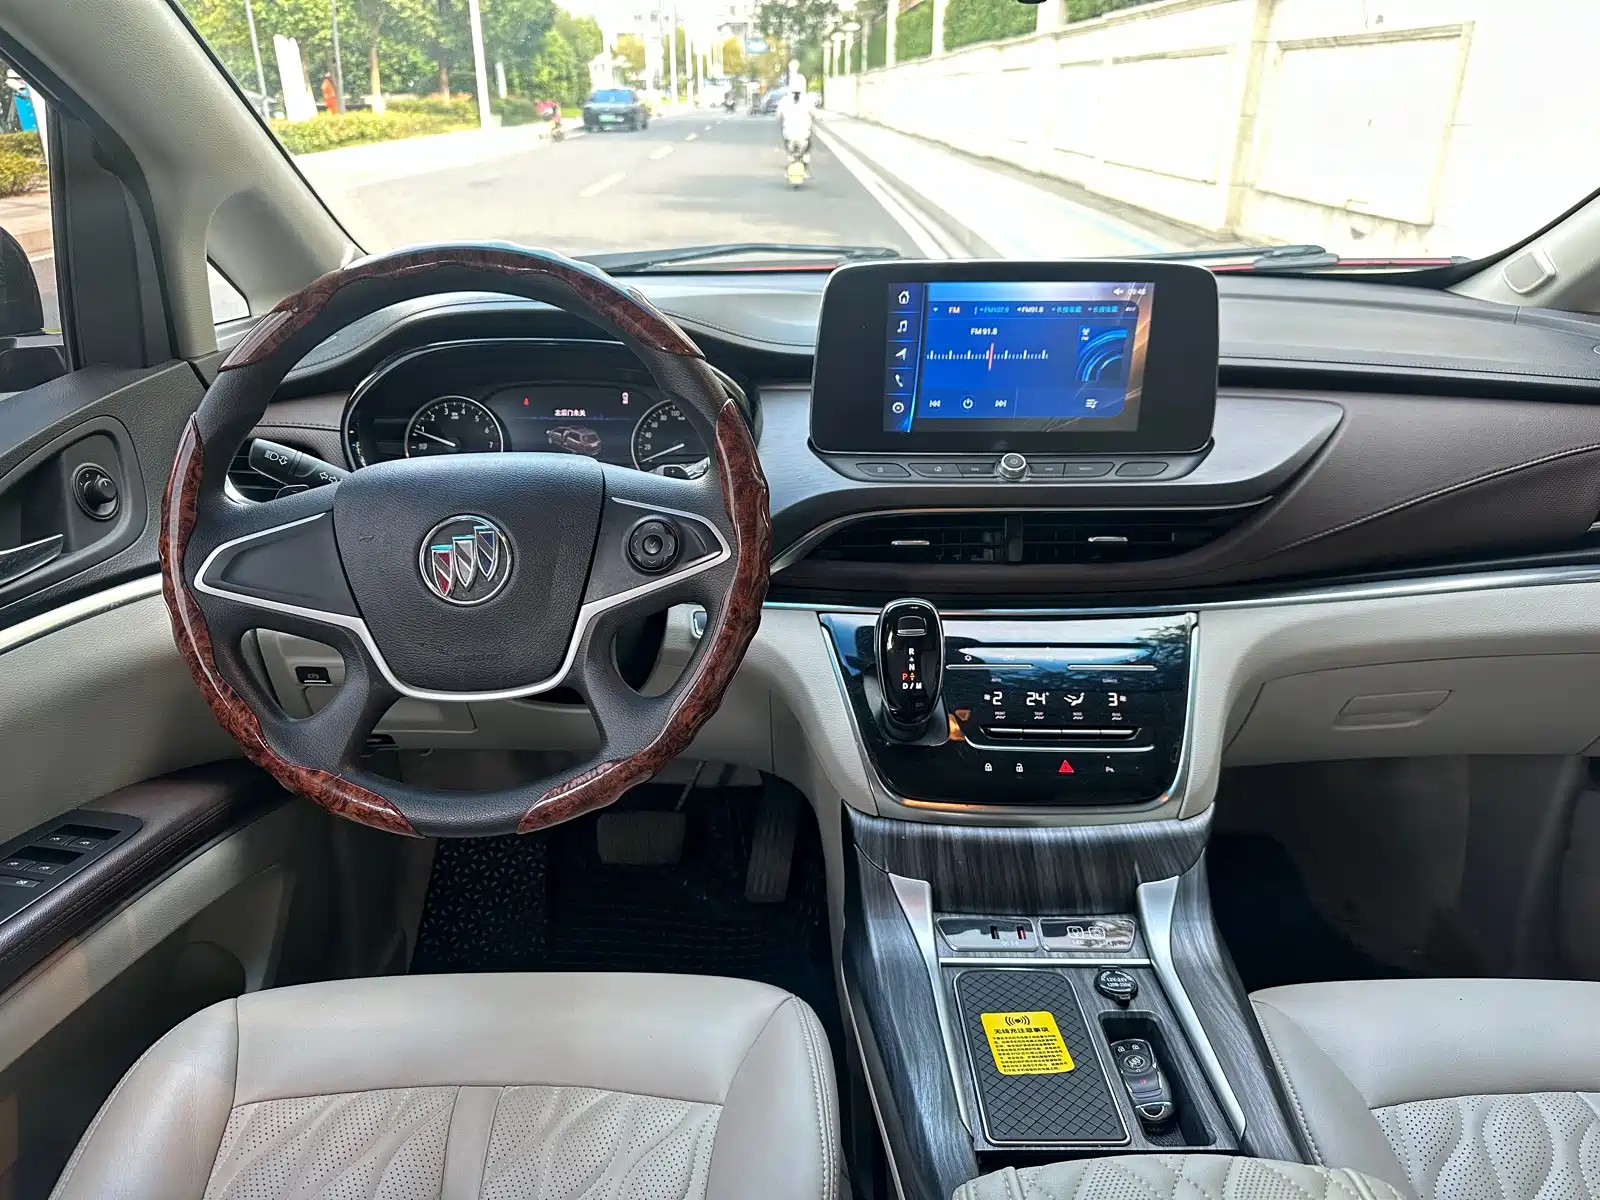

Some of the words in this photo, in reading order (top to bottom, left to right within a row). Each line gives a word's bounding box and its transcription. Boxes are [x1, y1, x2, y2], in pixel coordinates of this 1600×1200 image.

[948, 306, 960, 314] FM
[431, 414, 436, 422] 2
[644, 443, 652, 451] 20
[908, 647, 915, 656] R
[908, 663, 915, 671] N
[902, 672, 908, 681] P
[992, 691, 1003, 706] 2
[1107, 692, 1118, 707] 3
